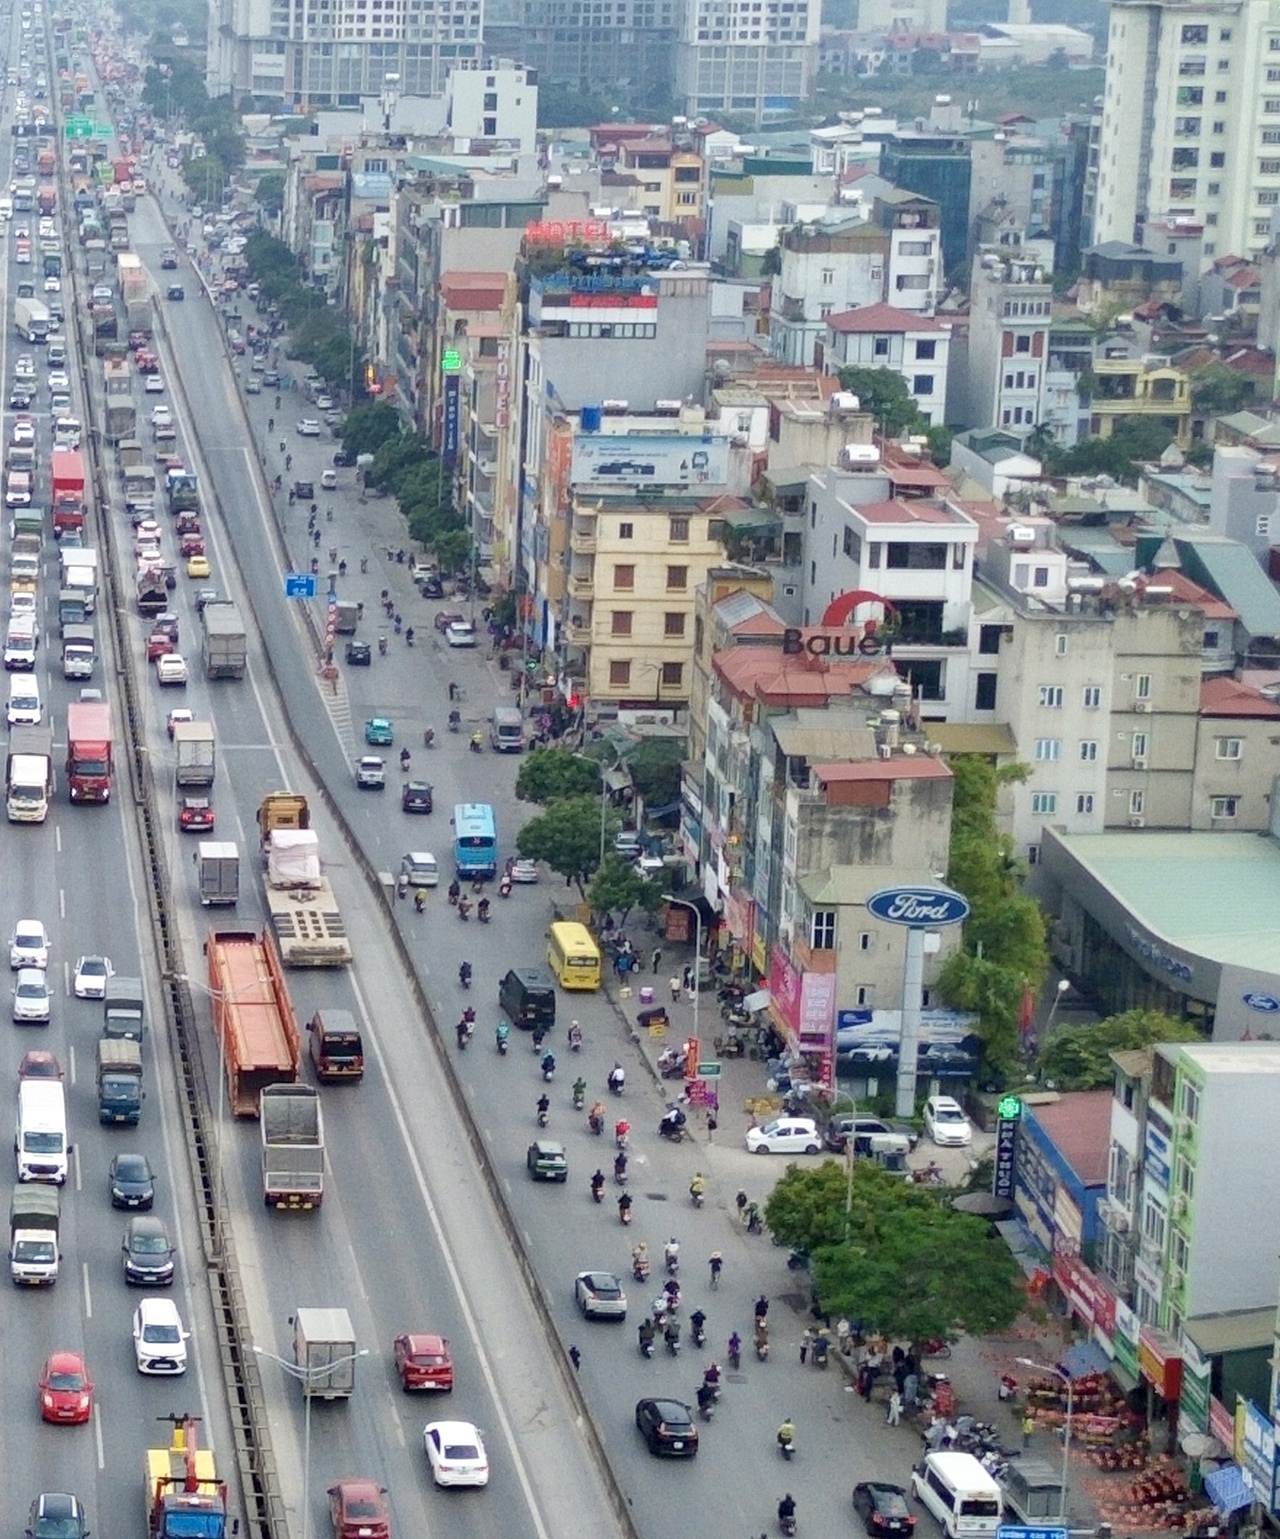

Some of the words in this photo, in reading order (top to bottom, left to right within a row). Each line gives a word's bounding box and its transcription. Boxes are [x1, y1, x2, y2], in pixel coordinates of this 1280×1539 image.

[527, 219, 613, 242] HOTEL
[496, 343, 509, 428] HOTEL
[887, 894, 950, 919] Ford
